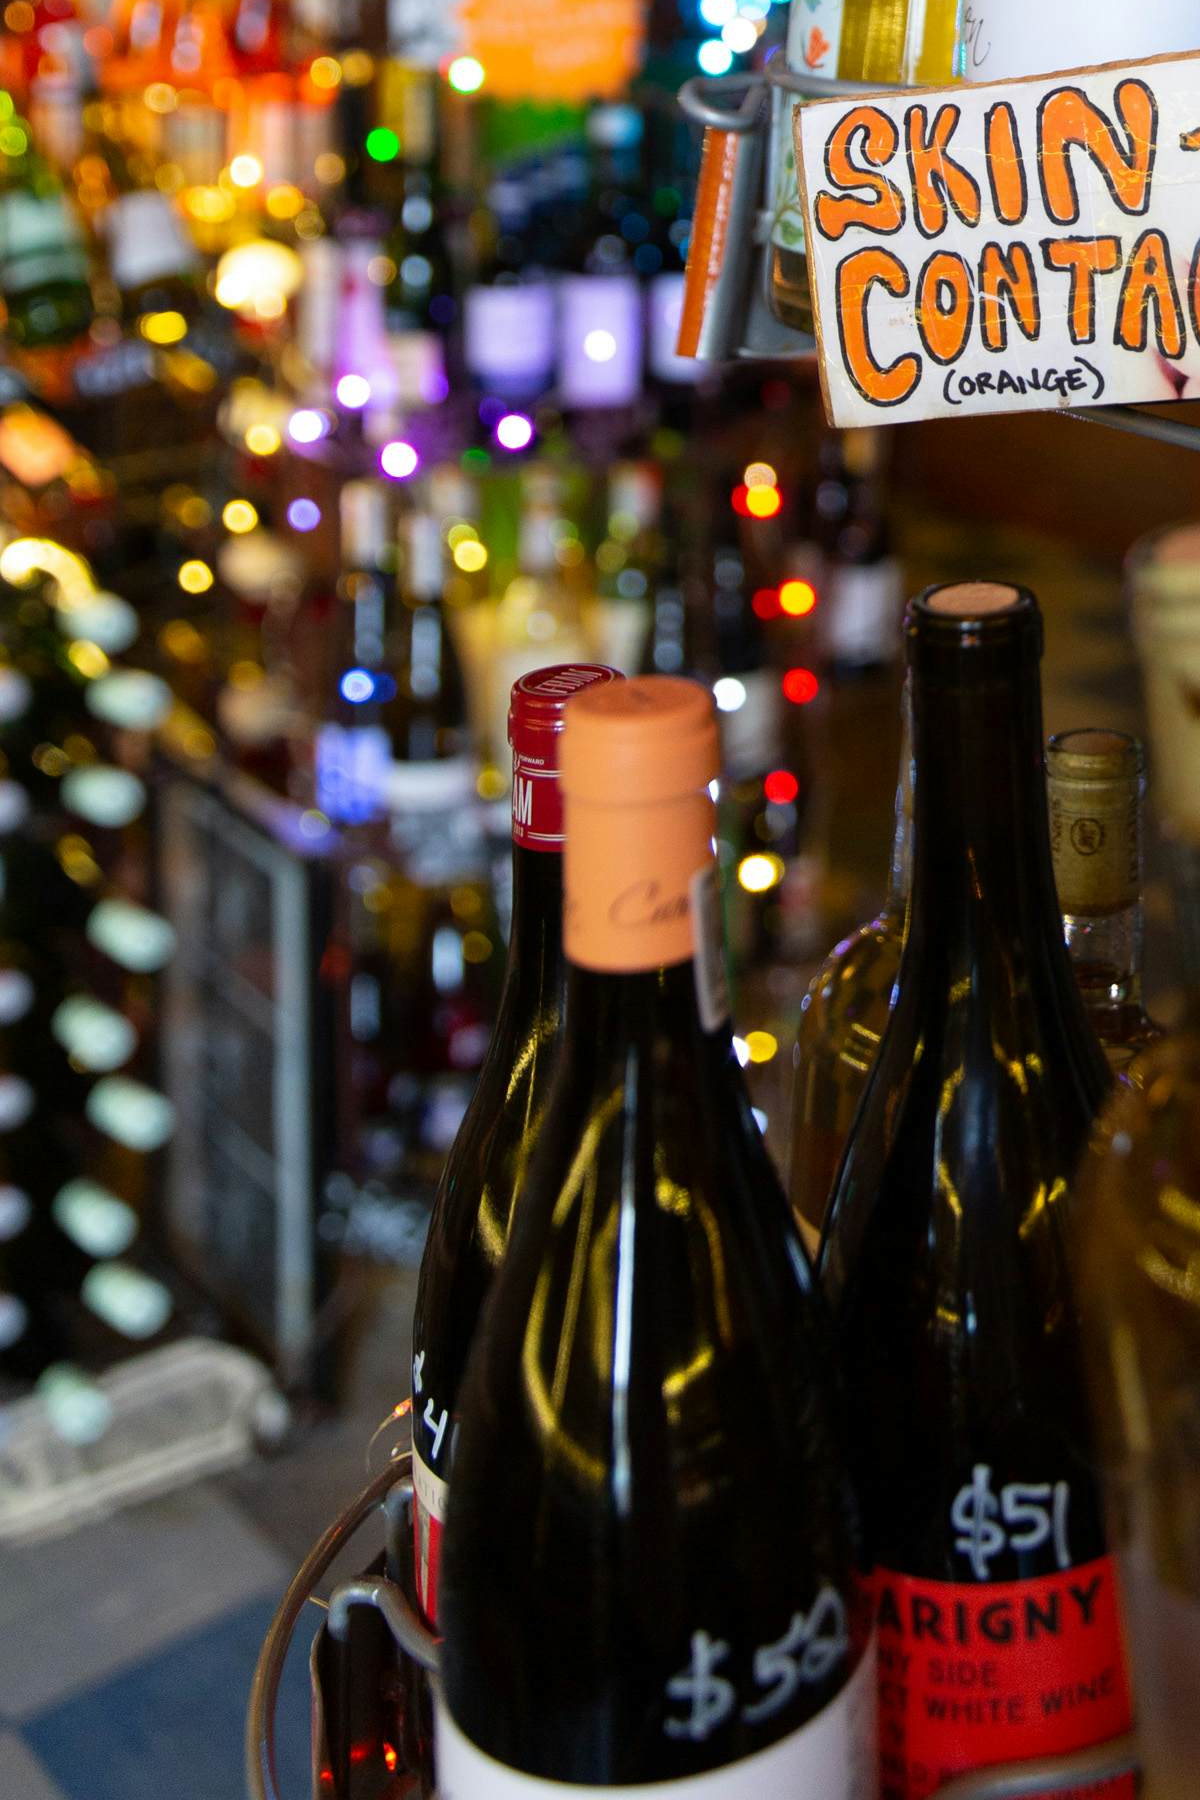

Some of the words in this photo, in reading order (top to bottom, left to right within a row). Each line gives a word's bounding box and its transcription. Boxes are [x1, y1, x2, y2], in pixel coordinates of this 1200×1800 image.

[942, 355, 1105, 405] (ORANGE)
[512, 773, 533, 827] AM
[951, 1464, 1071, 1580] $51
[877, 1574, 1103, 1645] ARIGNY
